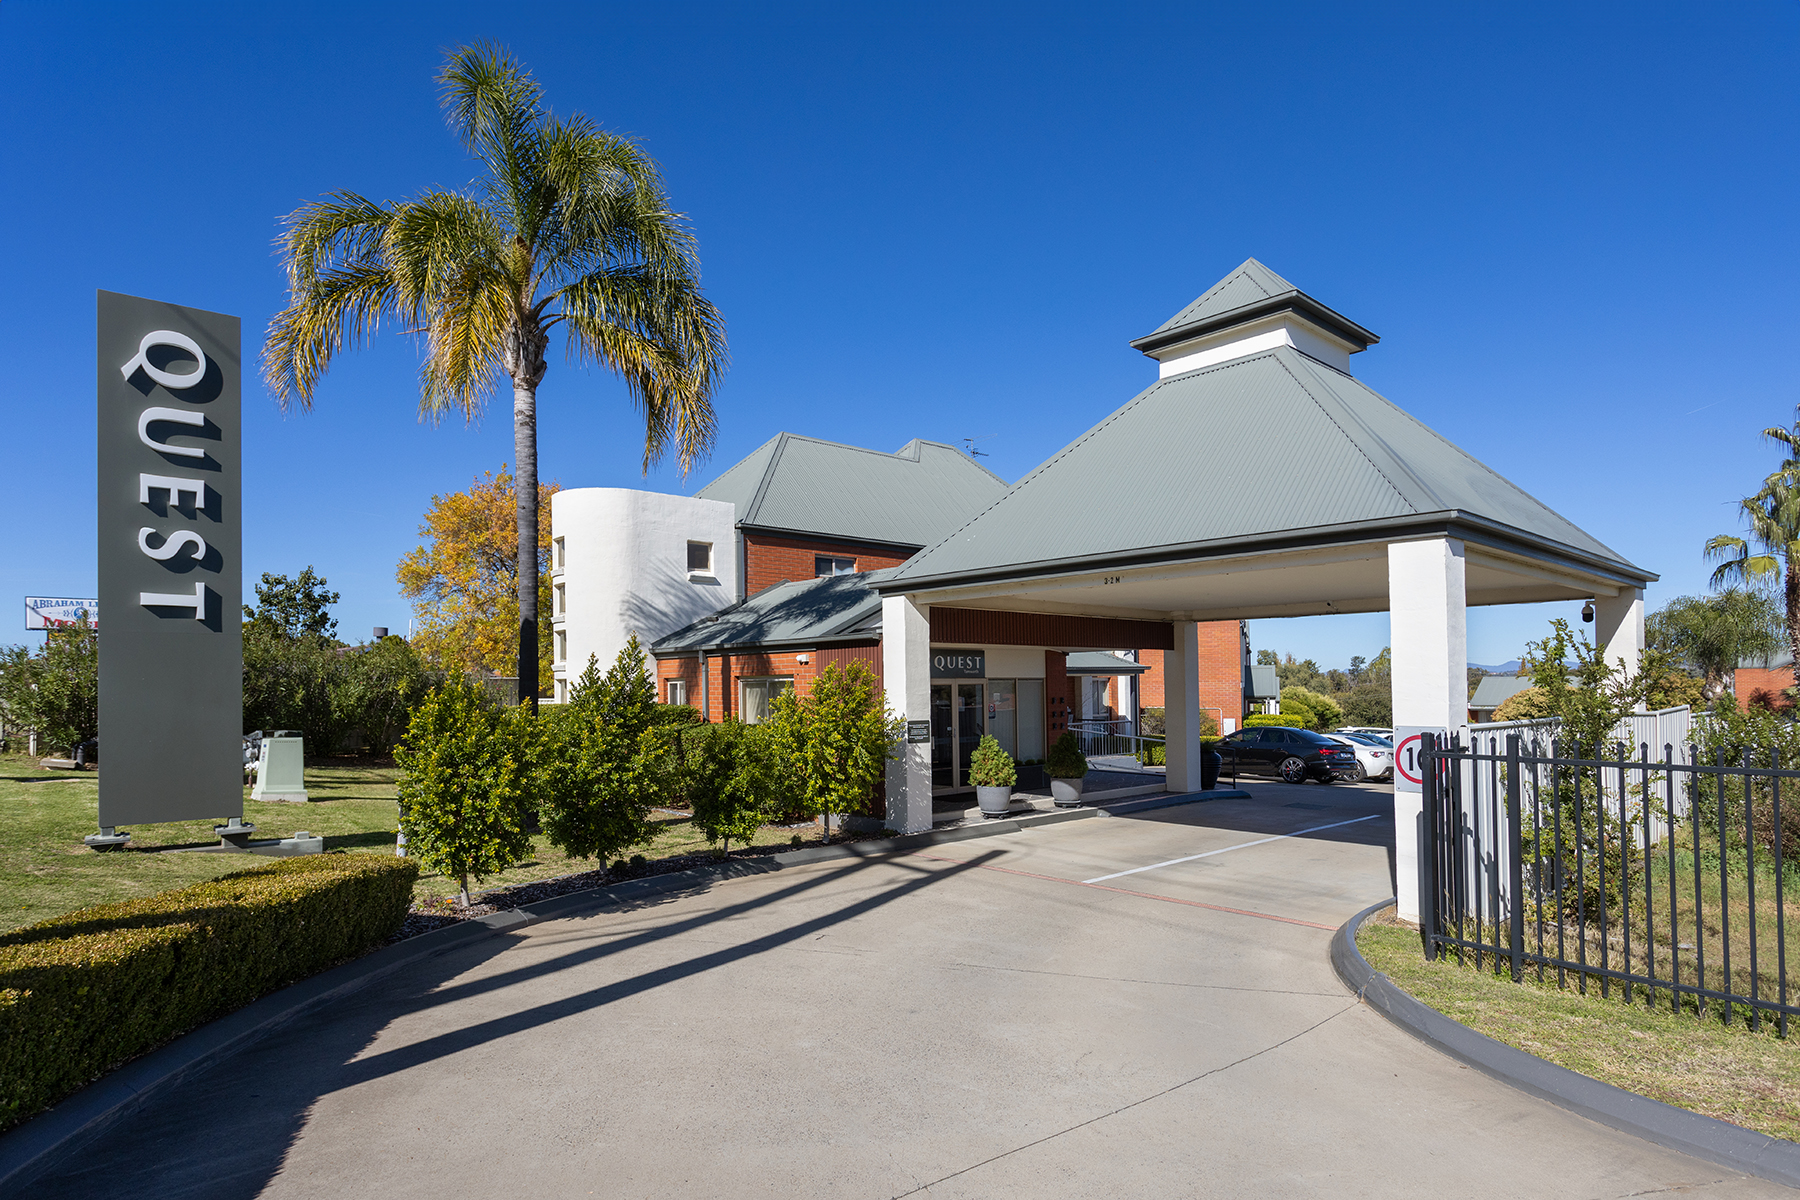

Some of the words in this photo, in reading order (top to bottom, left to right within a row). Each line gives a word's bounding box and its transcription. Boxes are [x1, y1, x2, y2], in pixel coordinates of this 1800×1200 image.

[120, 330, 206, 620] QUEST
[33, 599, 84, 609] ABRAHAM
[934, 655, 981, 671] QUEST
[1406, 747, 1423, 771] 1
